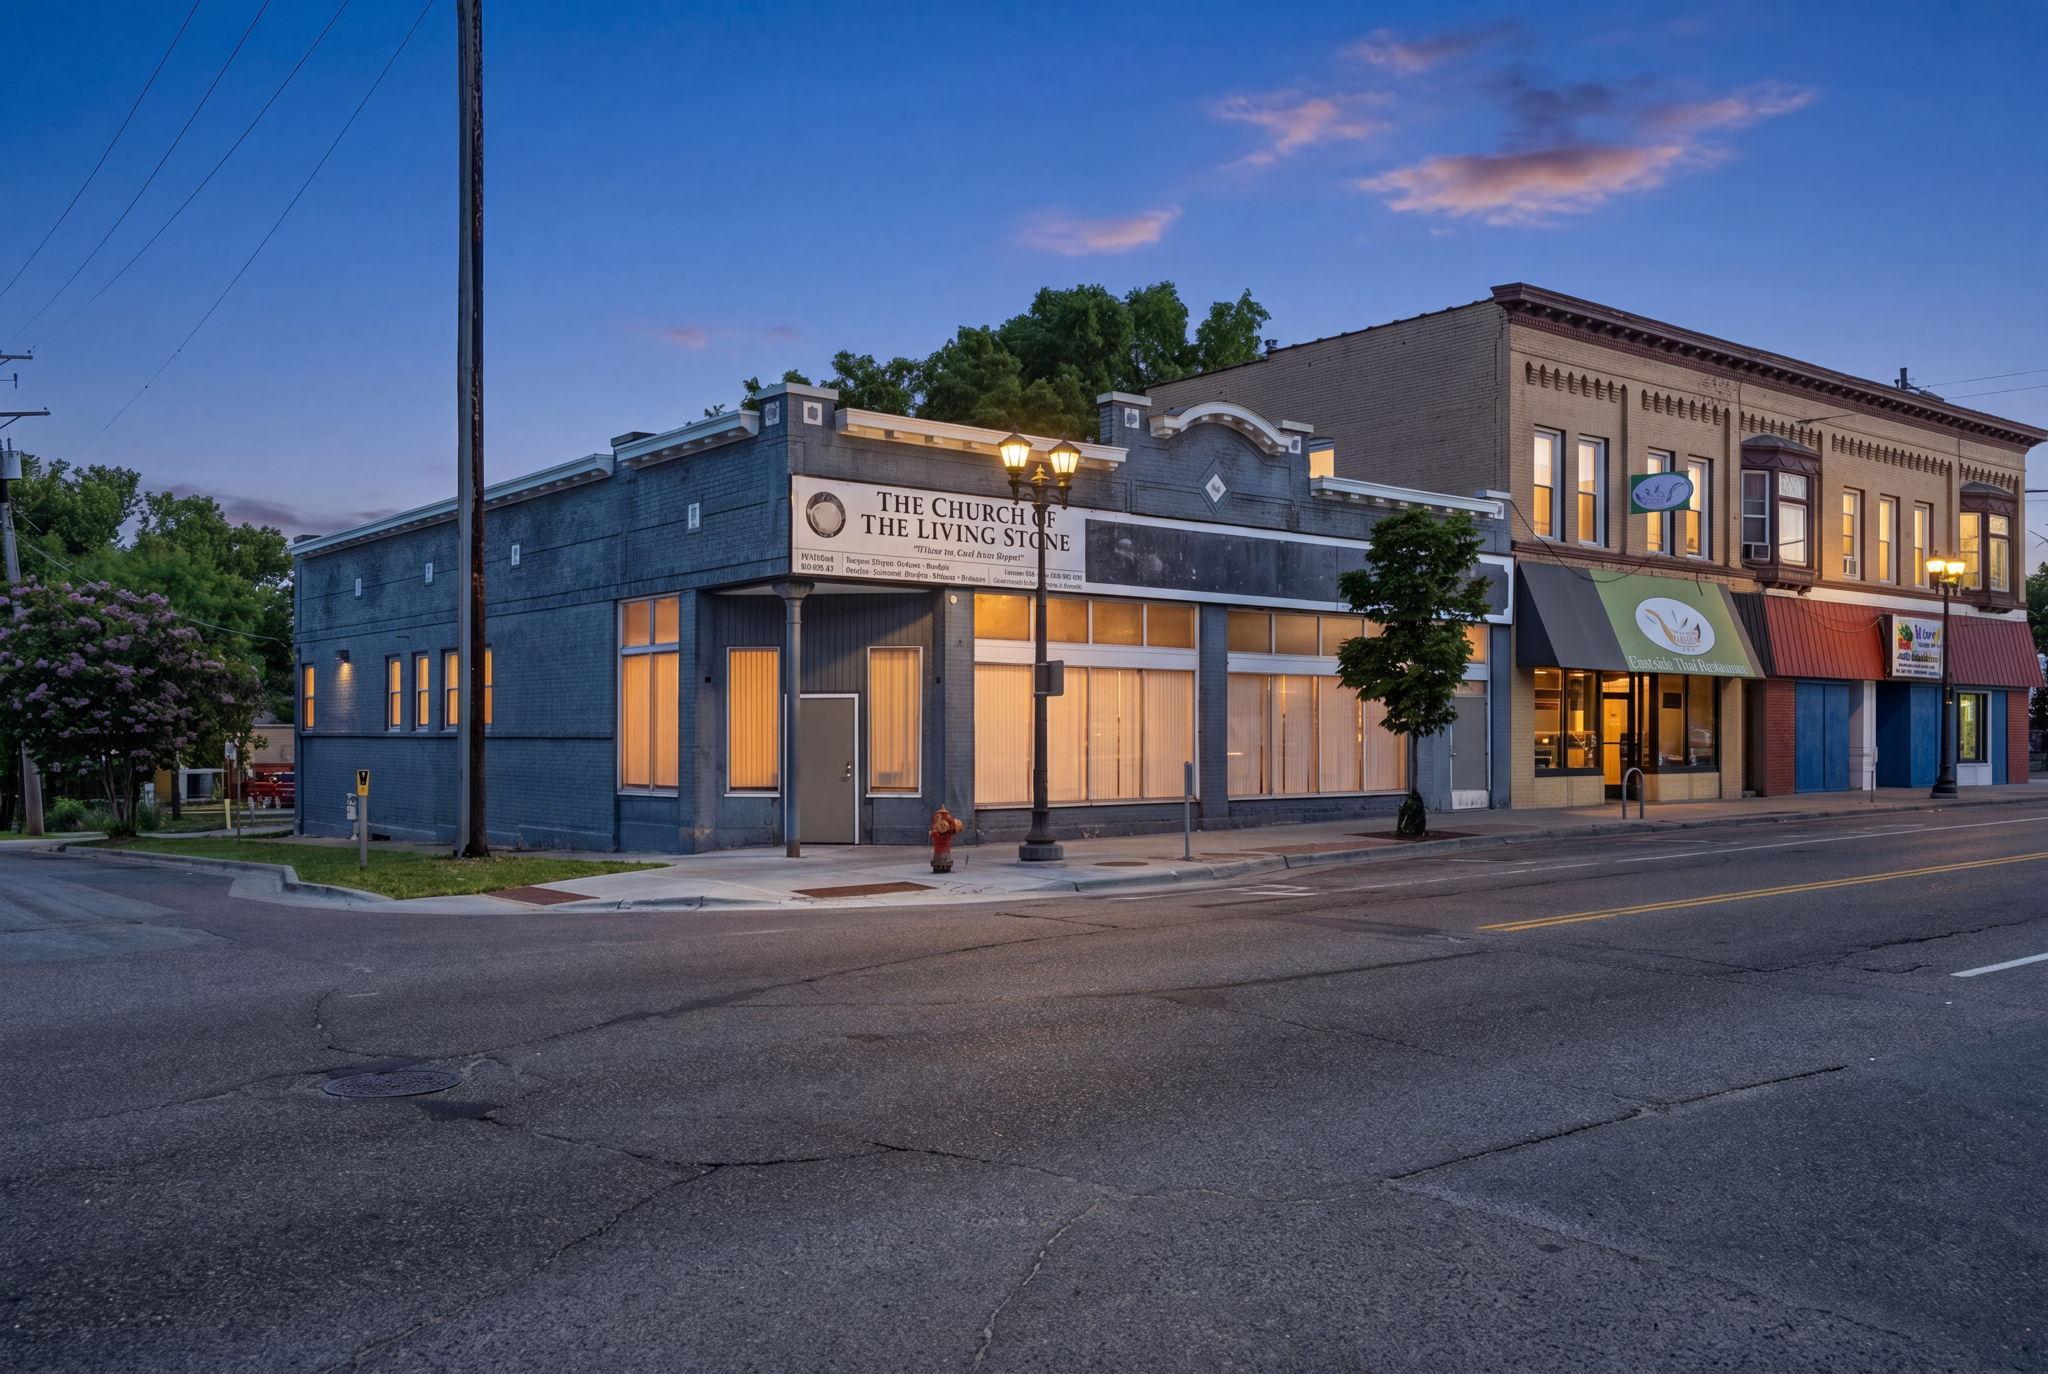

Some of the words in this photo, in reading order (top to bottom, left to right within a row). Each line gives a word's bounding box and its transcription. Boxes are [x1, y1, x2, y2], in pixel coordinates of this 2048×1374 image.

[877, 491, 924, 515] THE
[931, 497, 1026, 526] CHURCH
[861, 514, 909, 537] THE
[917, 518, 997, 545] LIVING
[1003, 527, 1070, 552] STONE
[1629, 655, 1674, 671] Eastside
[1673, 657, 1698, 672] Thai
